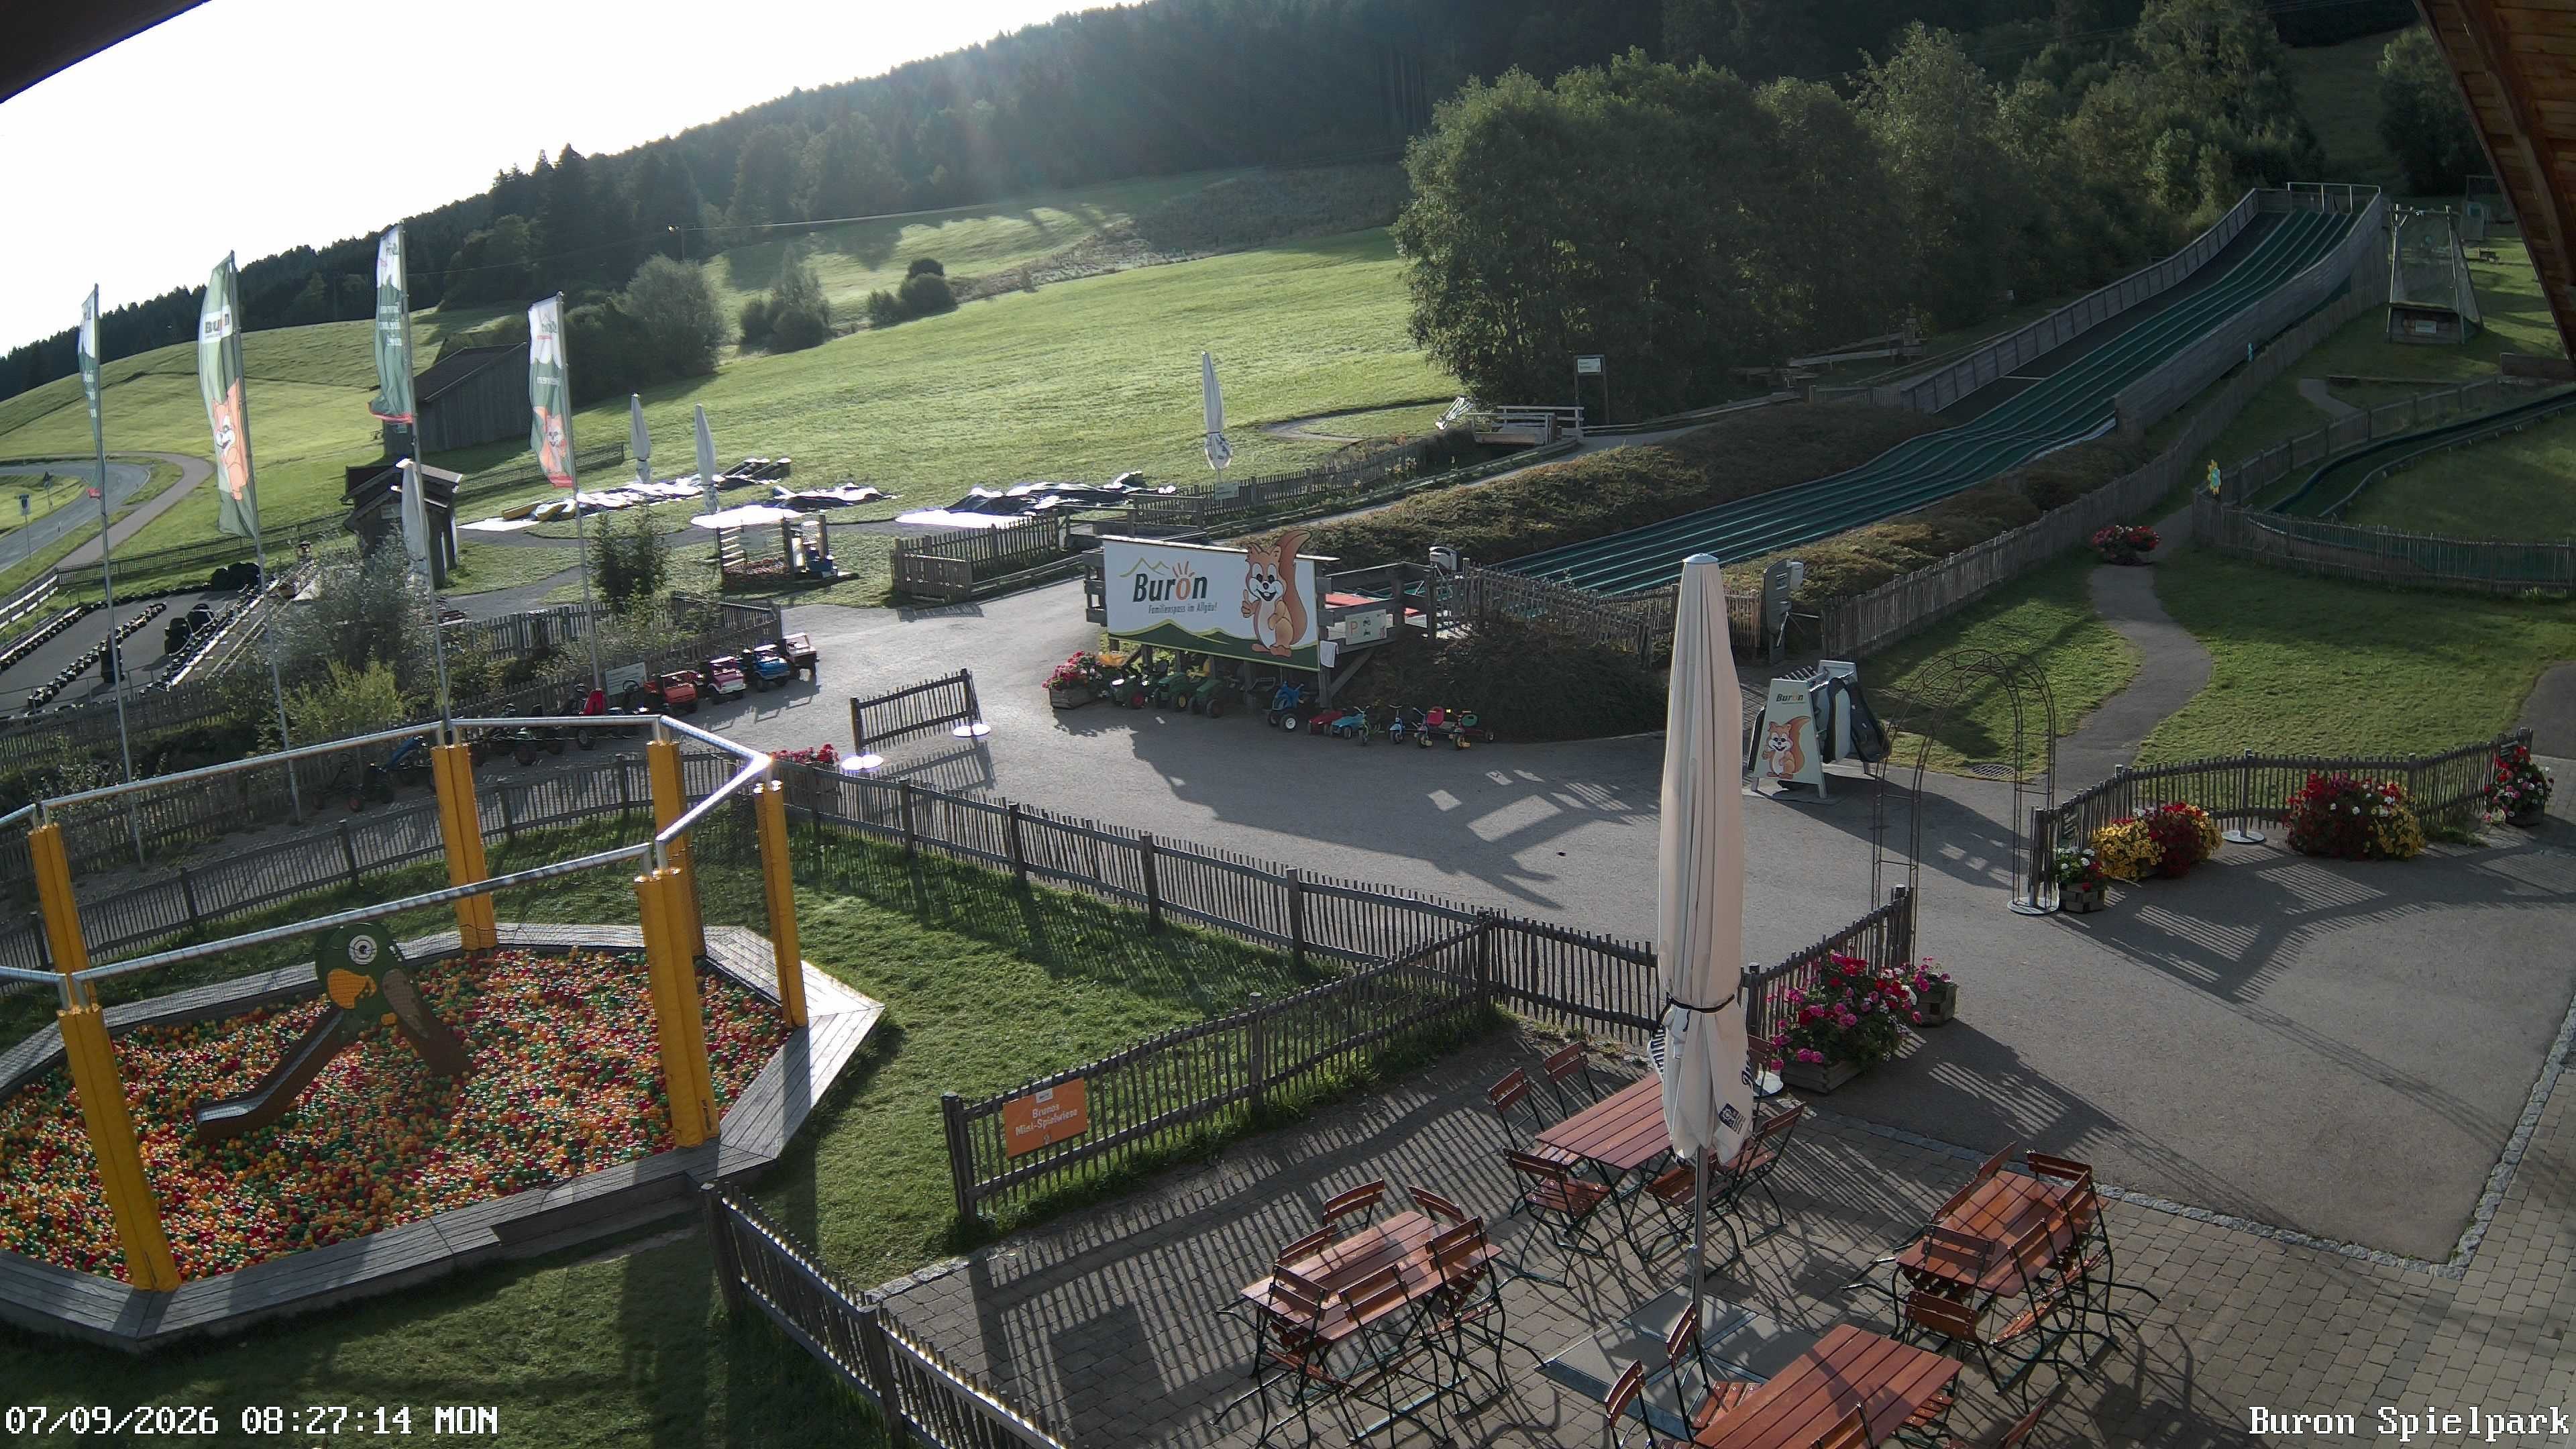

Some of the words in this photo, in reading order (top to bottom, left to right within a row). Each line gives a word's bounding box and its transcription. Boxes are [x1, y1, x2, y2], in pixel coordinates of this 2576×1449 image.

[1132, 573, 1208, 602] Buron
[1350, 621, 1358, 635] P
[1776, 693, 1804, 702] Buron
